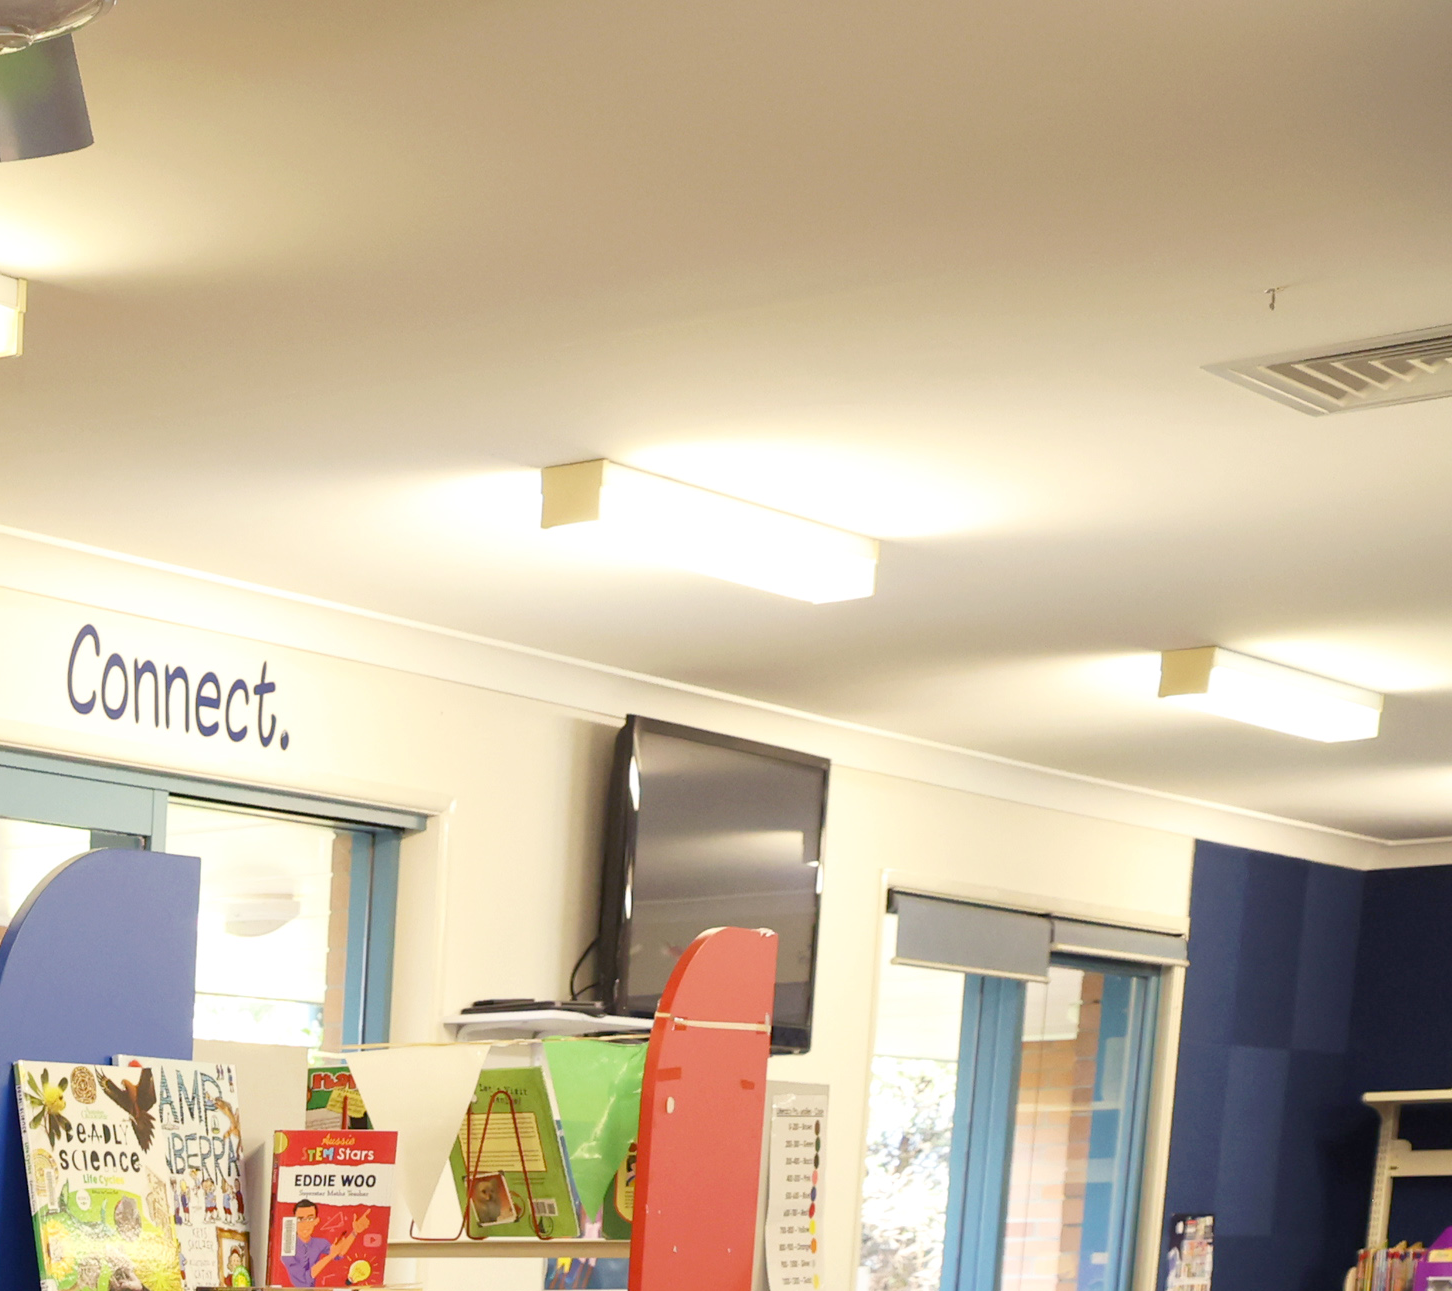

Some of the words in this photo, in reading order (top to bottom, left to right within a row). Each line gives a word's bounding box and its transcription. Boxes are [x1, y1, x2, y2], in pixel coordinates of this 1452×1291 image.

[67, 624, 289, 751] Connect.
[158, 1065, 223, 1135] AMP
[301, 1147, 335, 1162] STEM
[336, 1148, 375, 1161] Stars
[294, 1174, 336, 1187] EDDIE
[341, 1174, 377, 1187] WOO
